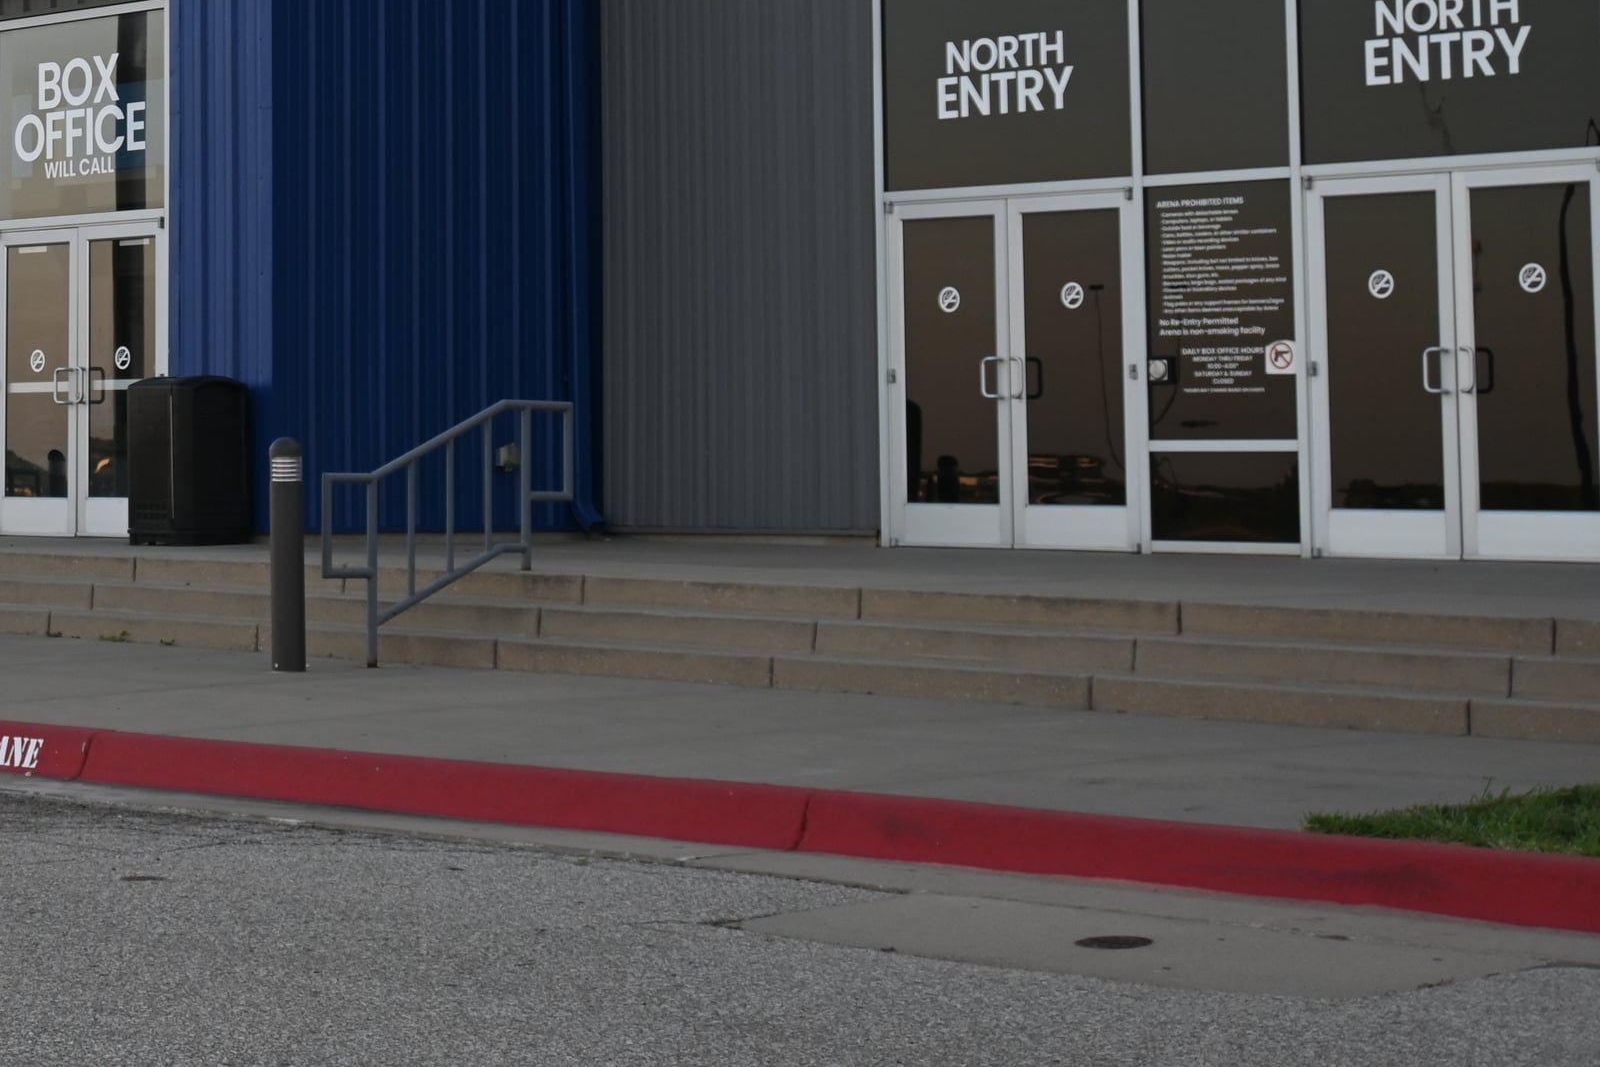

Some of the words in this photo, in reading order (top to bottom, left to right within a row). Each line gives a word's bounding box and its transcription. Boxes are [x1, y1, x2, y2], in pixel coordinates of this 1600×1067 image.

[947, 31, 1063, 74] NORTH
[1365, 26, 1531, 85] ENTRY
[39, 53, 119, 110] BOX
[938, 66, 1073, 119] ENTRY
[15, 102, 145, 162] OFFICE
[45, 156, 76, 178] WILL
[79, 156, 114, 175] CALL
[1157, 200, 1180, 208] ARENA
[1181, 198, 1222, 206] PROHIBITED
[1223, 196, 1244, 204] ITEMS
[1170, 318, 1201, 327] Re-Entry
[1203, 317, 1238, 326] Permitted
[1190, 327, 1239, 336] non-smoking
[1240, 326, 1265, 335] facility
